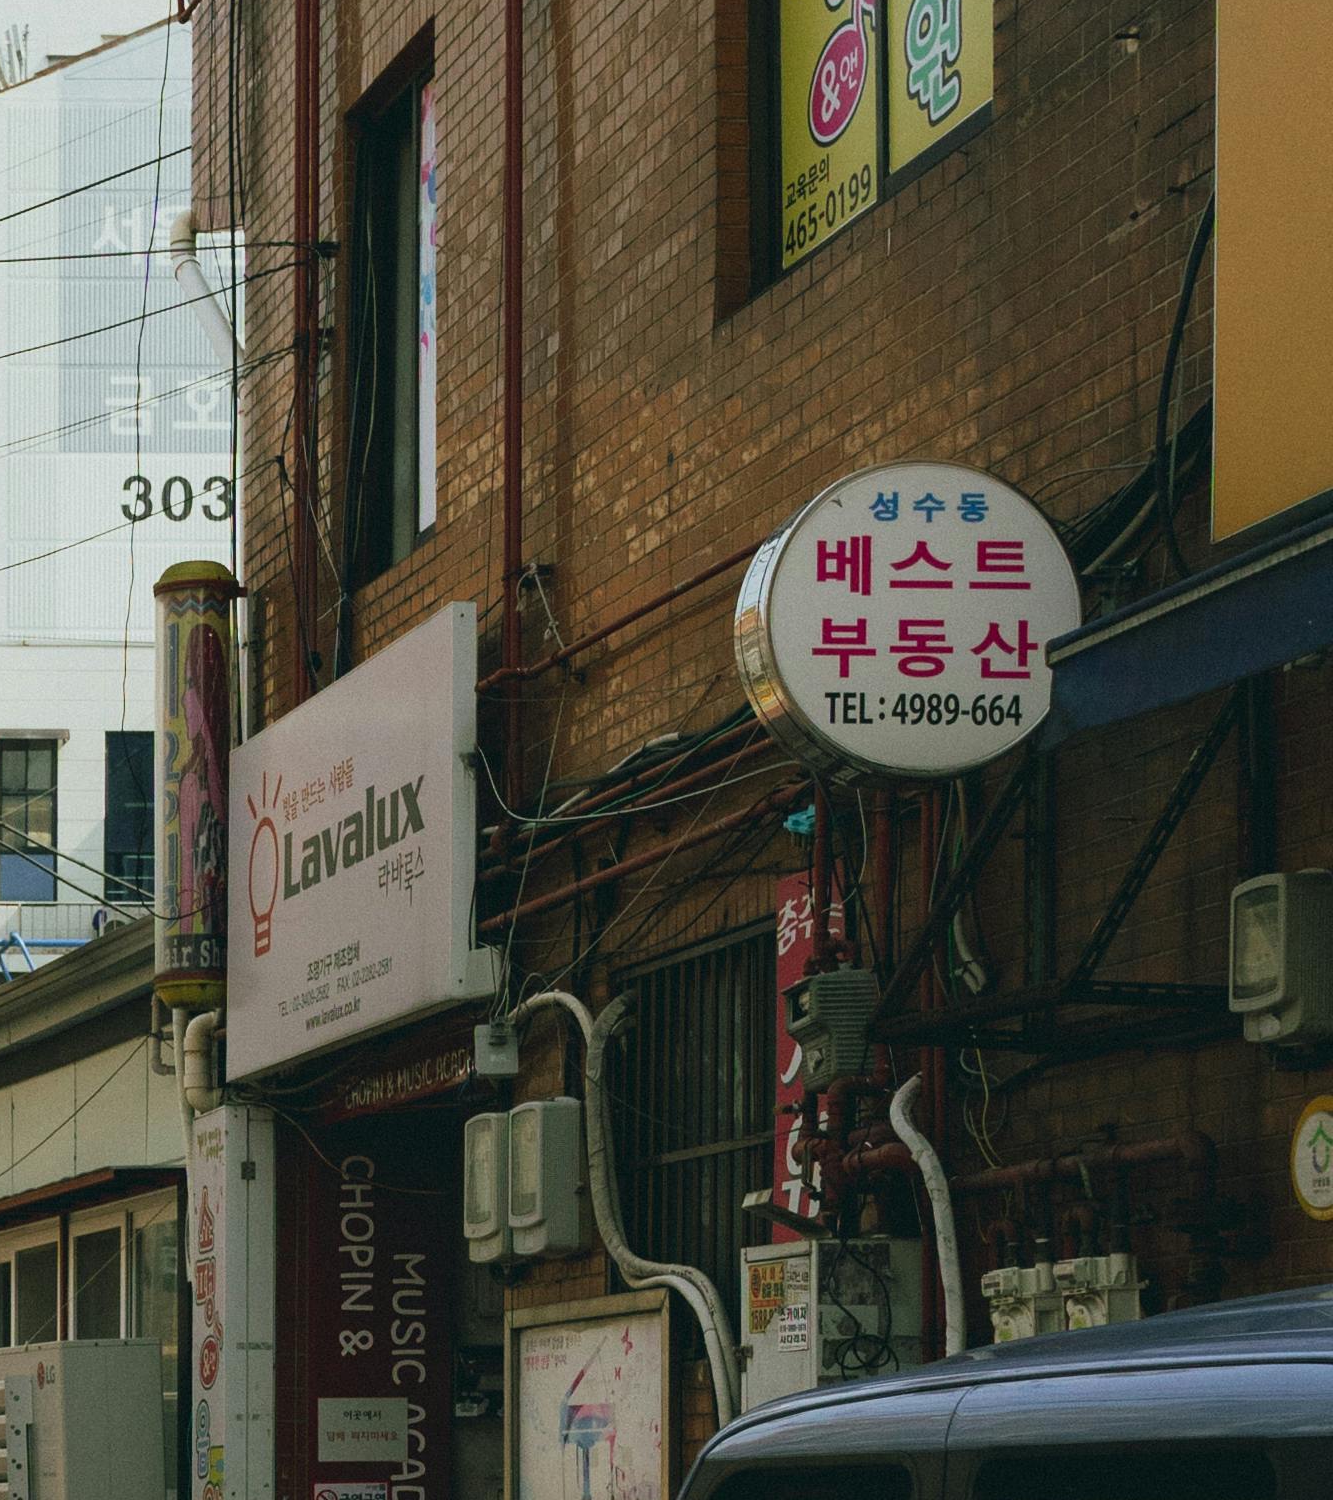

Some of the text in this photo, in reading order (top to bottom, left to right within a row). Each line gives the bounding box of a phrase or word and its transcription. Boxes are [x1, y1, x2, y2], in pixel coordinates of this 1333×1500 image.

[785, 154, 830, 209] 교육문의
[785, 164, 871, 256] 465-0199
[121, 475, 233, 522] 303
[869, 491, 989, 523] 성수동
[815, 534, 1032, 596] 베스트
[811, 618, 1038, 680] 부동산
[284, 774, 425, 900] Lavalux
[378, 846, 425, 907] 라바룩스
[396, 1058, 433, 1100] MUSIC
[339, 1155, 375, 1357] CHOPIN &
[391, 1253, 426, 1385] MUSIC
[46, 1365, 56, 1385] LG
[343, 1410, 382, 1421] 이곳에서
